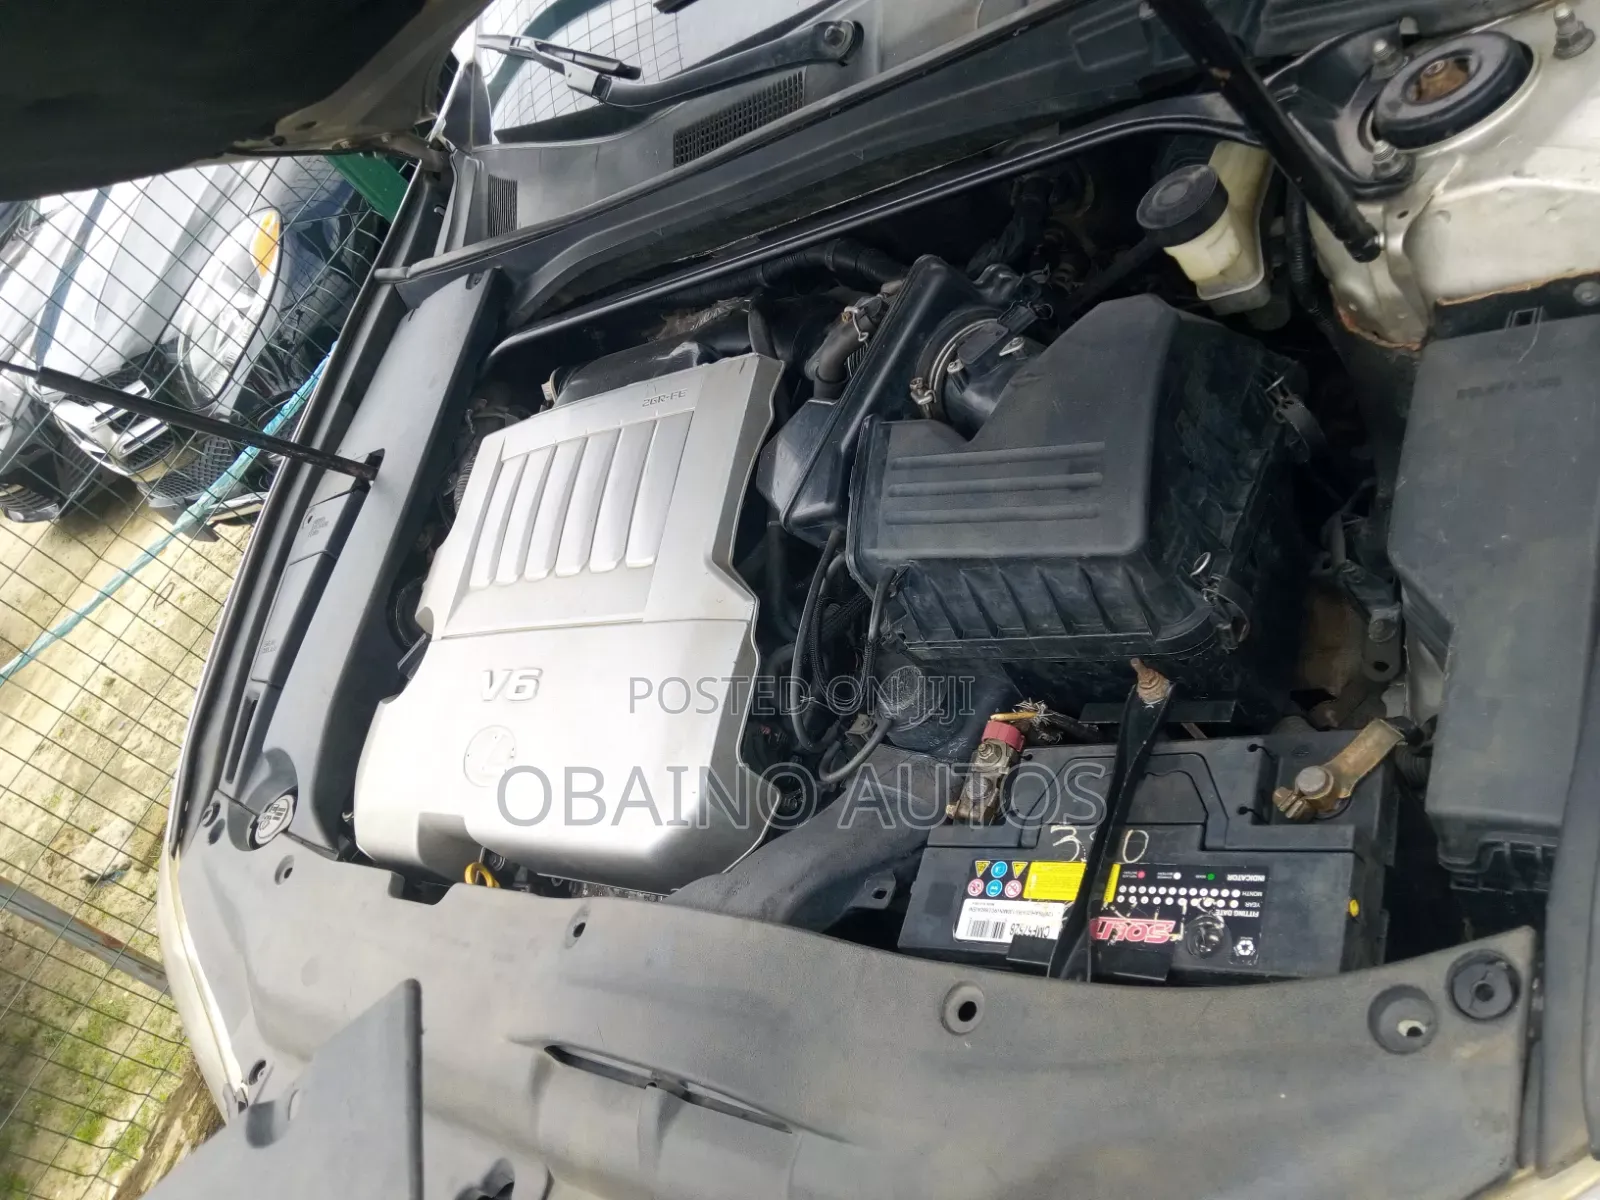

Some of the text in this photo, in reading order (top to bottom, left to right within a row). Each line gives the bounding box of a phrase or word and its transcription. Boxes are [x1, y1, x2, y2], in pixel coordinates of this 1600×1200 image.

[642, 388, 688, 408] 2GR-FE
[481, 667, 544, 702] V6
[1050, 825, 1150, 864] 30
[1227, 874, 1265, 882] INDICATOR
[1215, 909, 1260, 918] FITTING DATE
